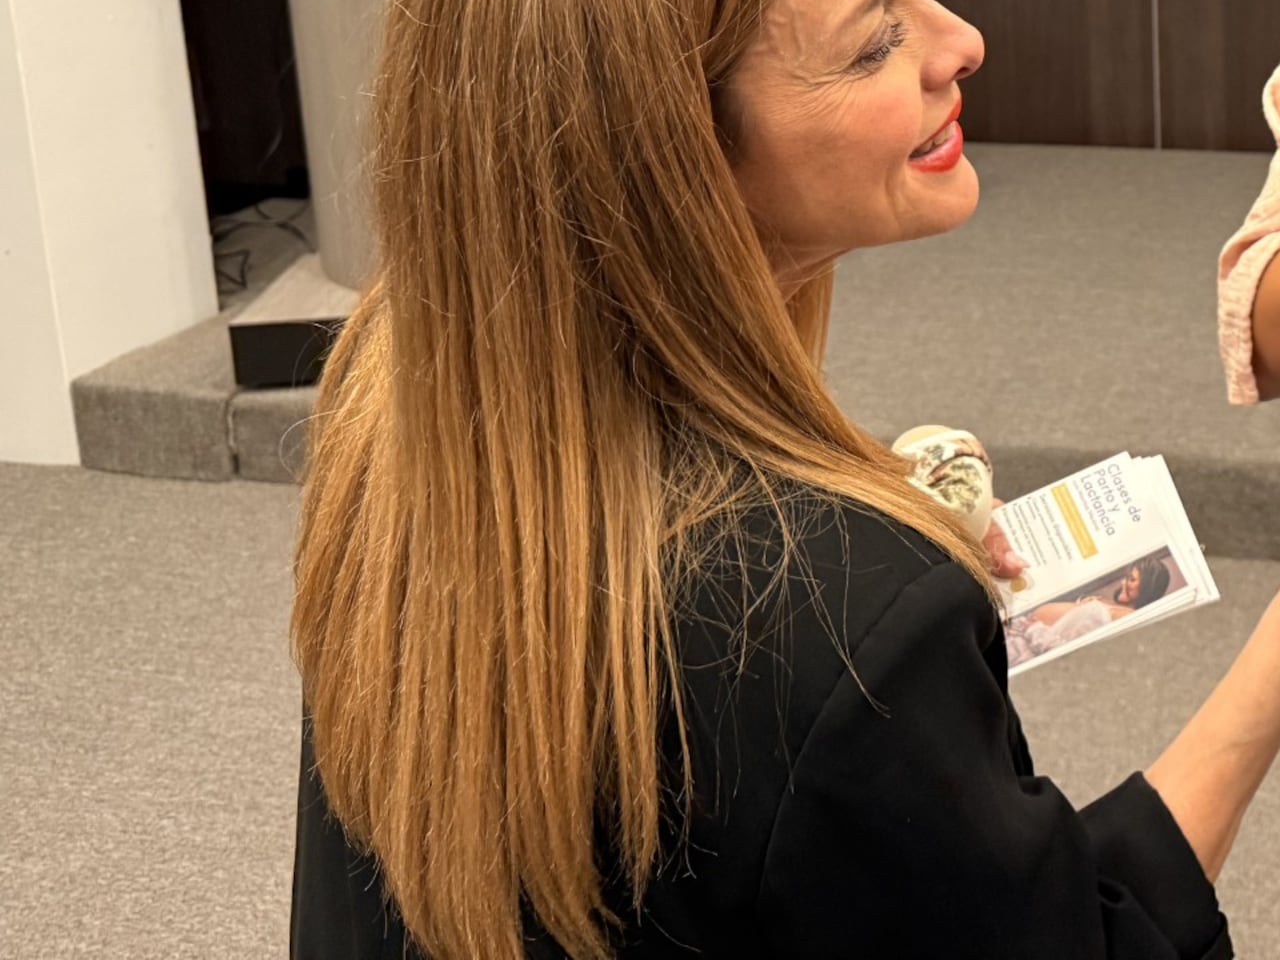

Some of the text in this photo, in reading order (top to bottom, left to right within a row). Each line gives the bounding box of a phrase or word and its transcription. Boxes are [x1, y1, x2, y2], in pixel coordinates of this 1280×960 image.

[1080, 474, 1116, 536] Lactancia
[1094, 468, 1121, 513] Parto y
[1107, 463, 1142, 523] Clases de
